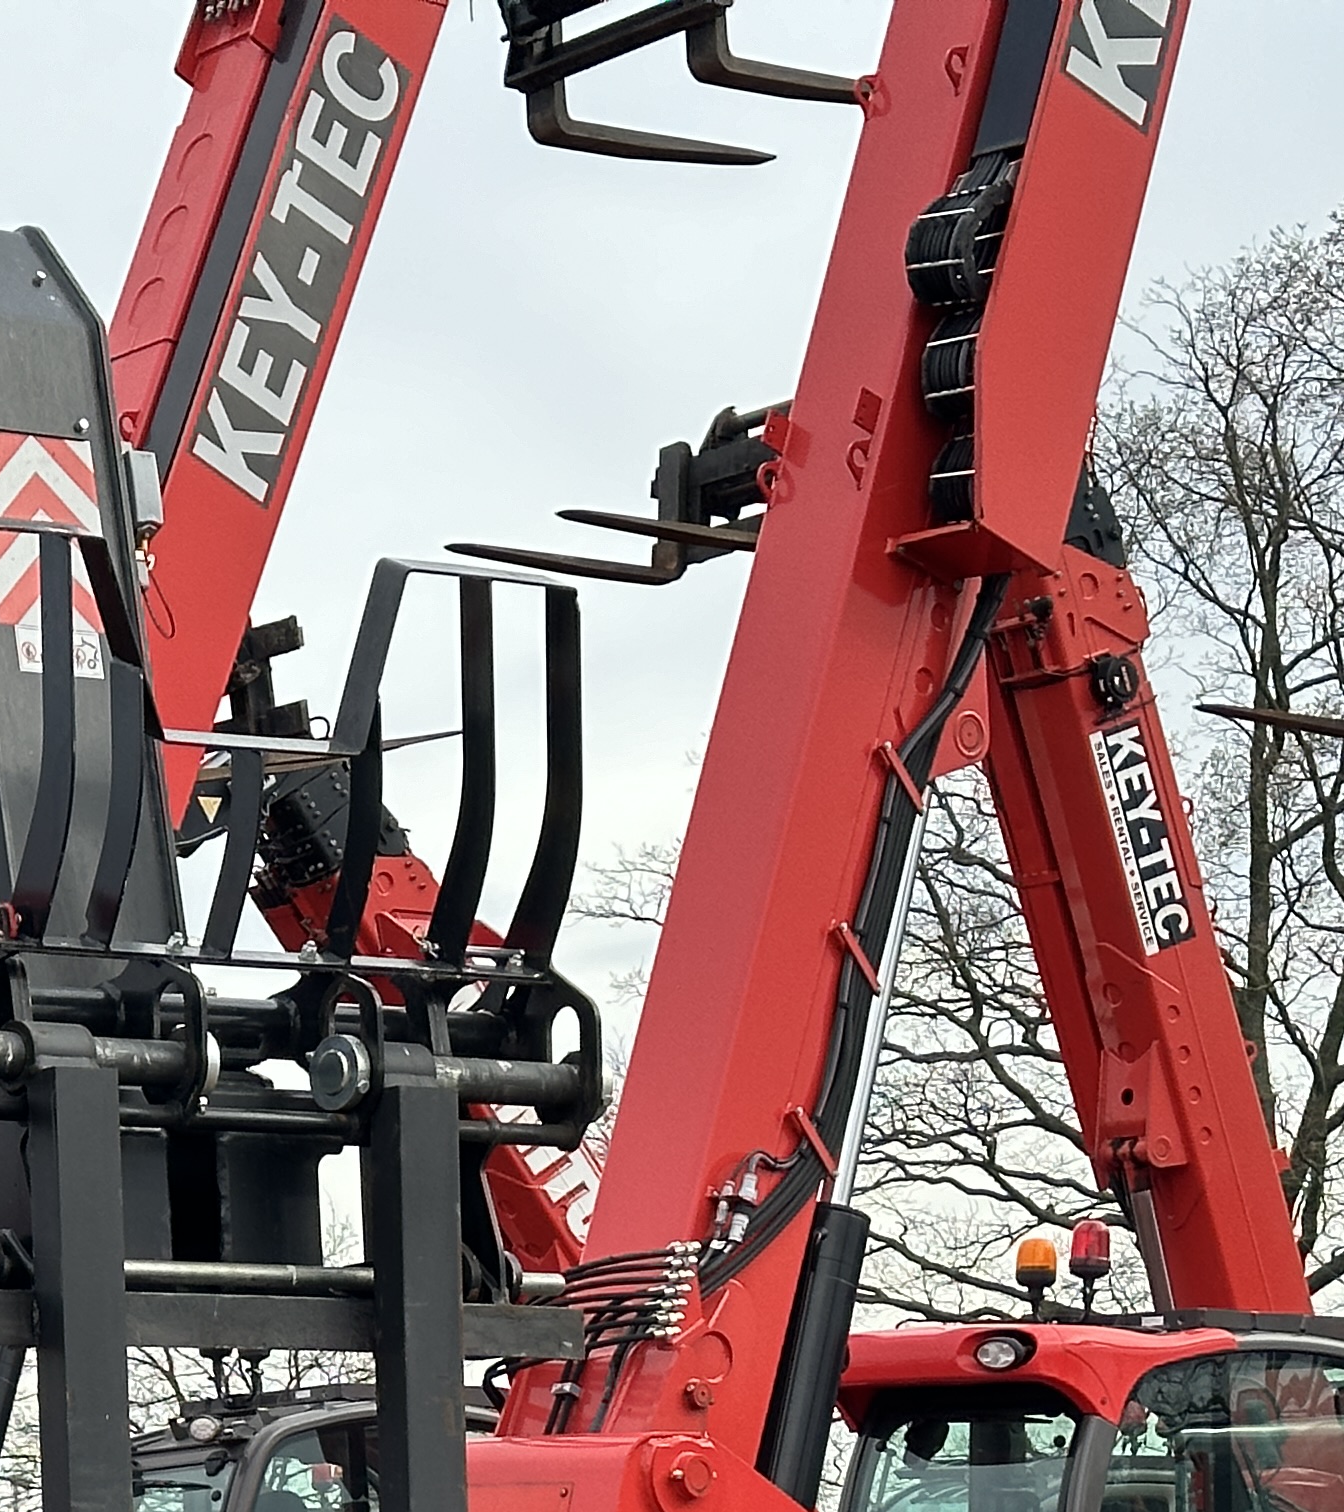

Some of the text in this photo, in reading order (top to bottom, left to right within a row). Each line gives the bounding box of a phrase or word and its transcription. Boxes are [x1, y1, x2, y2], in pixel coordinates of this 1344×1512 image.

[1066, 0, 1172, 126] K
[192, 31, 400, 502] KEY-TEC
[1094, 740, 1154, 946] SALES RENTAL SERVICE
[1106, 725, 1190, 940] KEY-TEC
